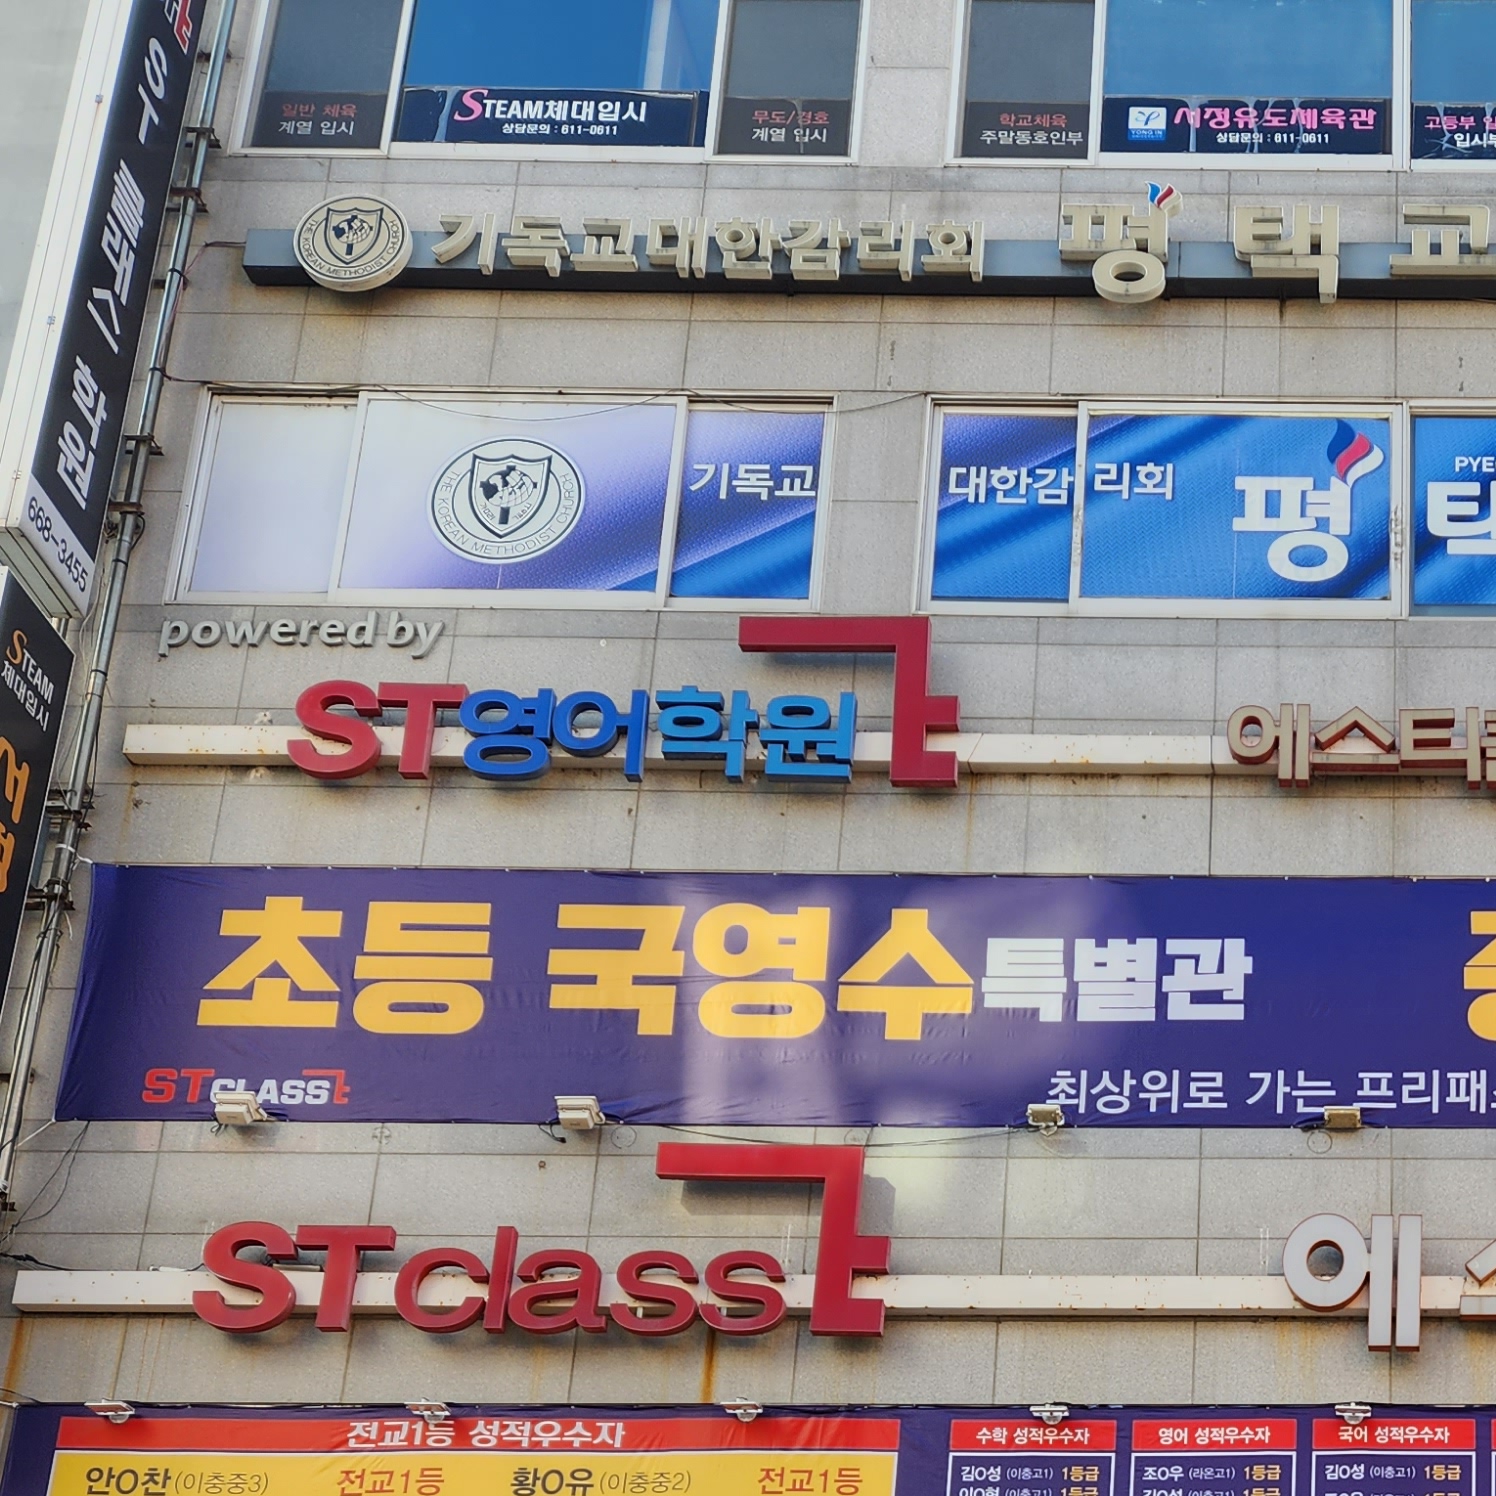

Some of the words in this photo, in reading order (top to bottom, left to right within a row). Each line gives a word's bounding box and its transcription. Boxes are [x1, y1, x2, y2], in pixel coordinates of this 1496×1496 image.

[454, 88, 647, 122] STEAM체대입시
[320, 119, 355, 135] 입시
[502, 121, 550, 135] 상담문의
[561, 121, 618, 135] 611-0611
[999, 112, 1067, 128] 학교체육
[979, 129, 1083, 145] 주말동호인부
[430, 211, 984, 282] 기독교대한감리회
[440, 470, 460, 493] THE
[690, 462, 817, 501] 기독교
[556, 472, 574, 524] CHURCH
[437, 497, 470, 545] KOREAN
[26, 498, 88, 594] 668-3455
[471, 527, 558, 555] METHODIST
[157, 611, 379, 657] powered
[386, 611, 445, 659] by
[7, 630, 55, 705] STEAM
[287, 679, 857, 784] ST영어학원
[197, 896, 493, 1035] 초등
[1046, 1069, 1228, 1114] 최상위로
[1247, 1068, 1336, 1113] 가는
[346, 1421, 454, 1447] 전교1등
[469, 1421, 625, 1447] 성적우수자
[976, 1427, 1008, 1444] 수학
[1013, 1426, 1090, 1444] 성적우수자
[1159, 1427, 1188, 1444] 영어
[1195, 1425, 1270, 1444] 성적우수자
[1338, 1426, 1368, 1443] 국어
[1374, 1426, 1449, 1443] 성적우수자
[337, 1467, 445, 1496] 전교1등
[757, 1467, 862, 1495] 전교1등
[1062, 1465, 1099, 1482] 1등급
